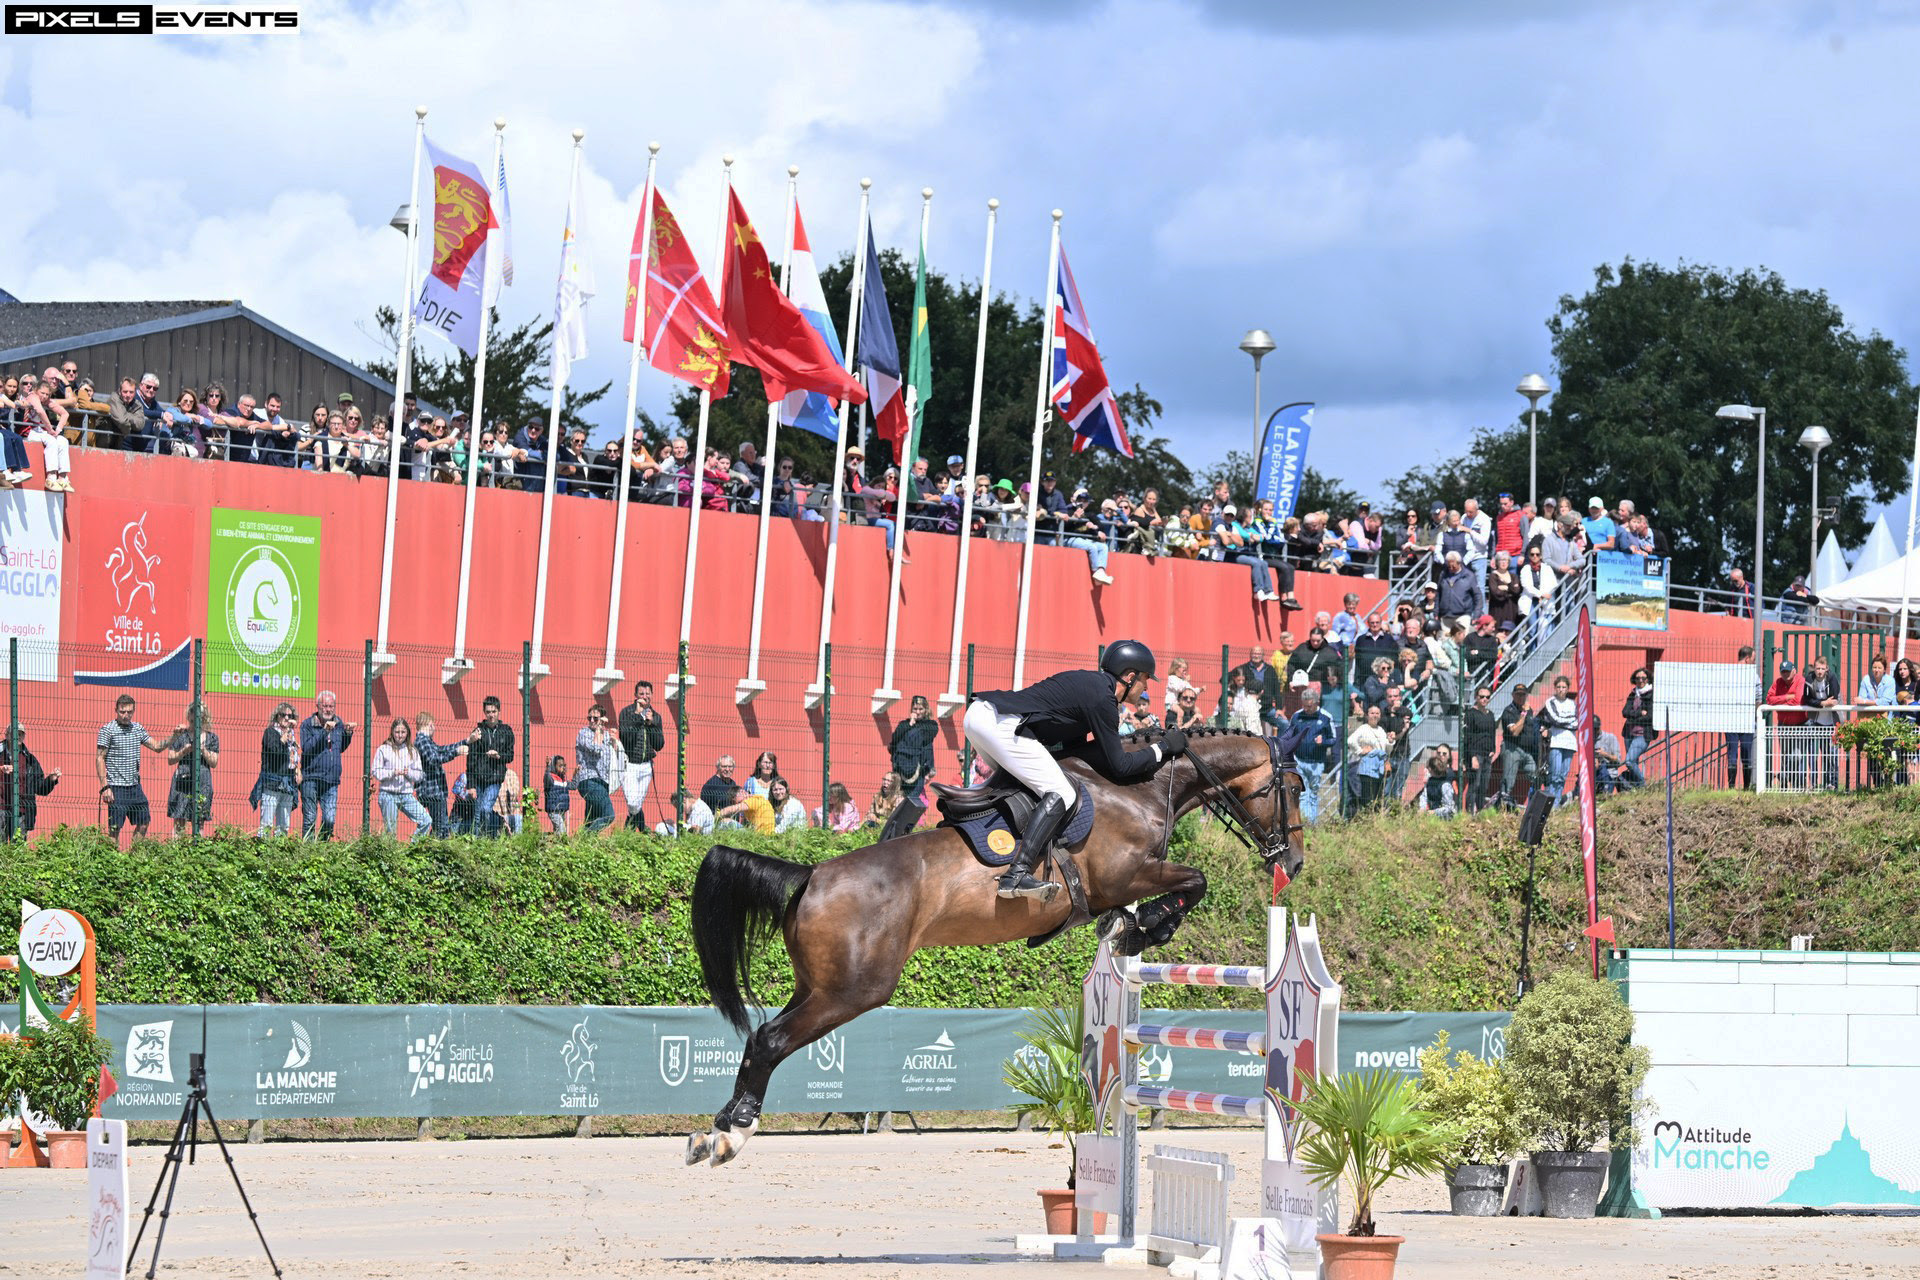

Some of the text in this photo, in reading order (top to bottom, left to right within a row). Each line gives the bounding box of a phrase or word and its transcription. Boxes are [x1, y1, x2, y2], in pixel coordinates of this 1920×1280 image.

[424, 300, 462, 332] DIE
[1274, 426, 1284, 440] LE
[1286, 428, 1300, 450] LA
[223, 529, 247, 539] BIEN-ÊTRE
[248, 531, 265, 540] ANIMAL
[246, 522, 257, 530] SITE
[0, 545, 56, 570] Saint-Lô
[0, 570, 57, 597] AGGLO
[1, 622, 45, 636] lo-agglo.fr
[114, 616, 143, 630] Ville de
[247, 620, 278, 633] EquuRES
[106, 630, 162, 654] Saint Lô
[28, 941, 77, 961] YEARLY
[1092, 971, 1111, 1026] SF
[1280, 978, 1304, 1040] SF
[694, 1037, 725, 1047] société
[450, 1044, 493, 1061] Saint-Lô
[694, 1051, 743, 1063] HIPPIQU
[1355, 1046, 1424, 1068] novelt
[902, 1054, 957, 1070] AGRIAL
[1228, 1060, 1266, 1077] tendan
[256, 1072, 338, 1089] LA MANCHE
[448, 1063, 494, 1083] AGGLO
[693, 1067, 740, 1077] FRANÇAISE
[127, 1083, 153, 1092] RÉGION
[566, 1085, 587, 1094] Ville de
[807, 1081, 843, 1089] NORMANDIE
[116, 1092, 182, 1107] NORMANDIE
[256, 1090, 336, 1105] LE DÉPARTEMENT
[560, 1093, 599, 1108] Saint Lô
[1684, 1127, 1751, 1143] Attitude
[1654, 1130, 1770, 1170] Manche
[1079, 1158, 1116, 1190] Selle Français
[1517, 1165, 1524, 1186] 3
[1266, 1186, 1313, 1222] Selle Français
[1254, 1225, 1264, 1251] 1
